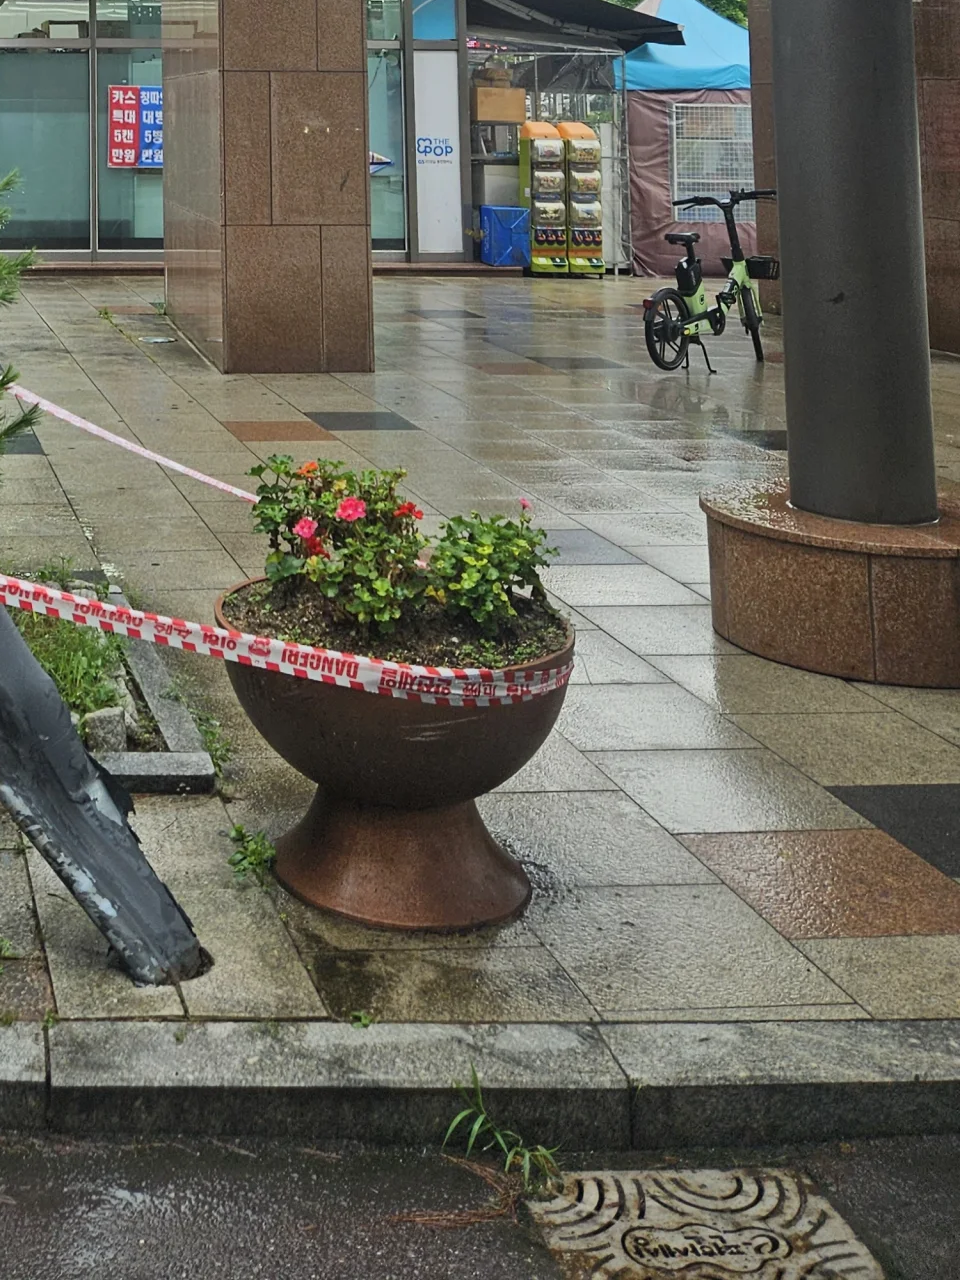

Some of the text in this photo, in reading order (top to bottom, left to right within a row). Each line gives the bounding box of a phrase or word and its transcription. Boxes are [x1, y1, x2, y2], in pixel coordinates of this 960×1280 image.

[112, 90, 136, 104] 카스
[140, 91, 163, 105] 칭따
[112, 109, 136, 124] 특대
[114, 129, 134, 143] 5캔
[112, 148, 136, 163] 만원
[141, 149, 164, 163] 만원
[424, 145, 453, 157] POP
[380, 667, 452, 696] 안전제일
